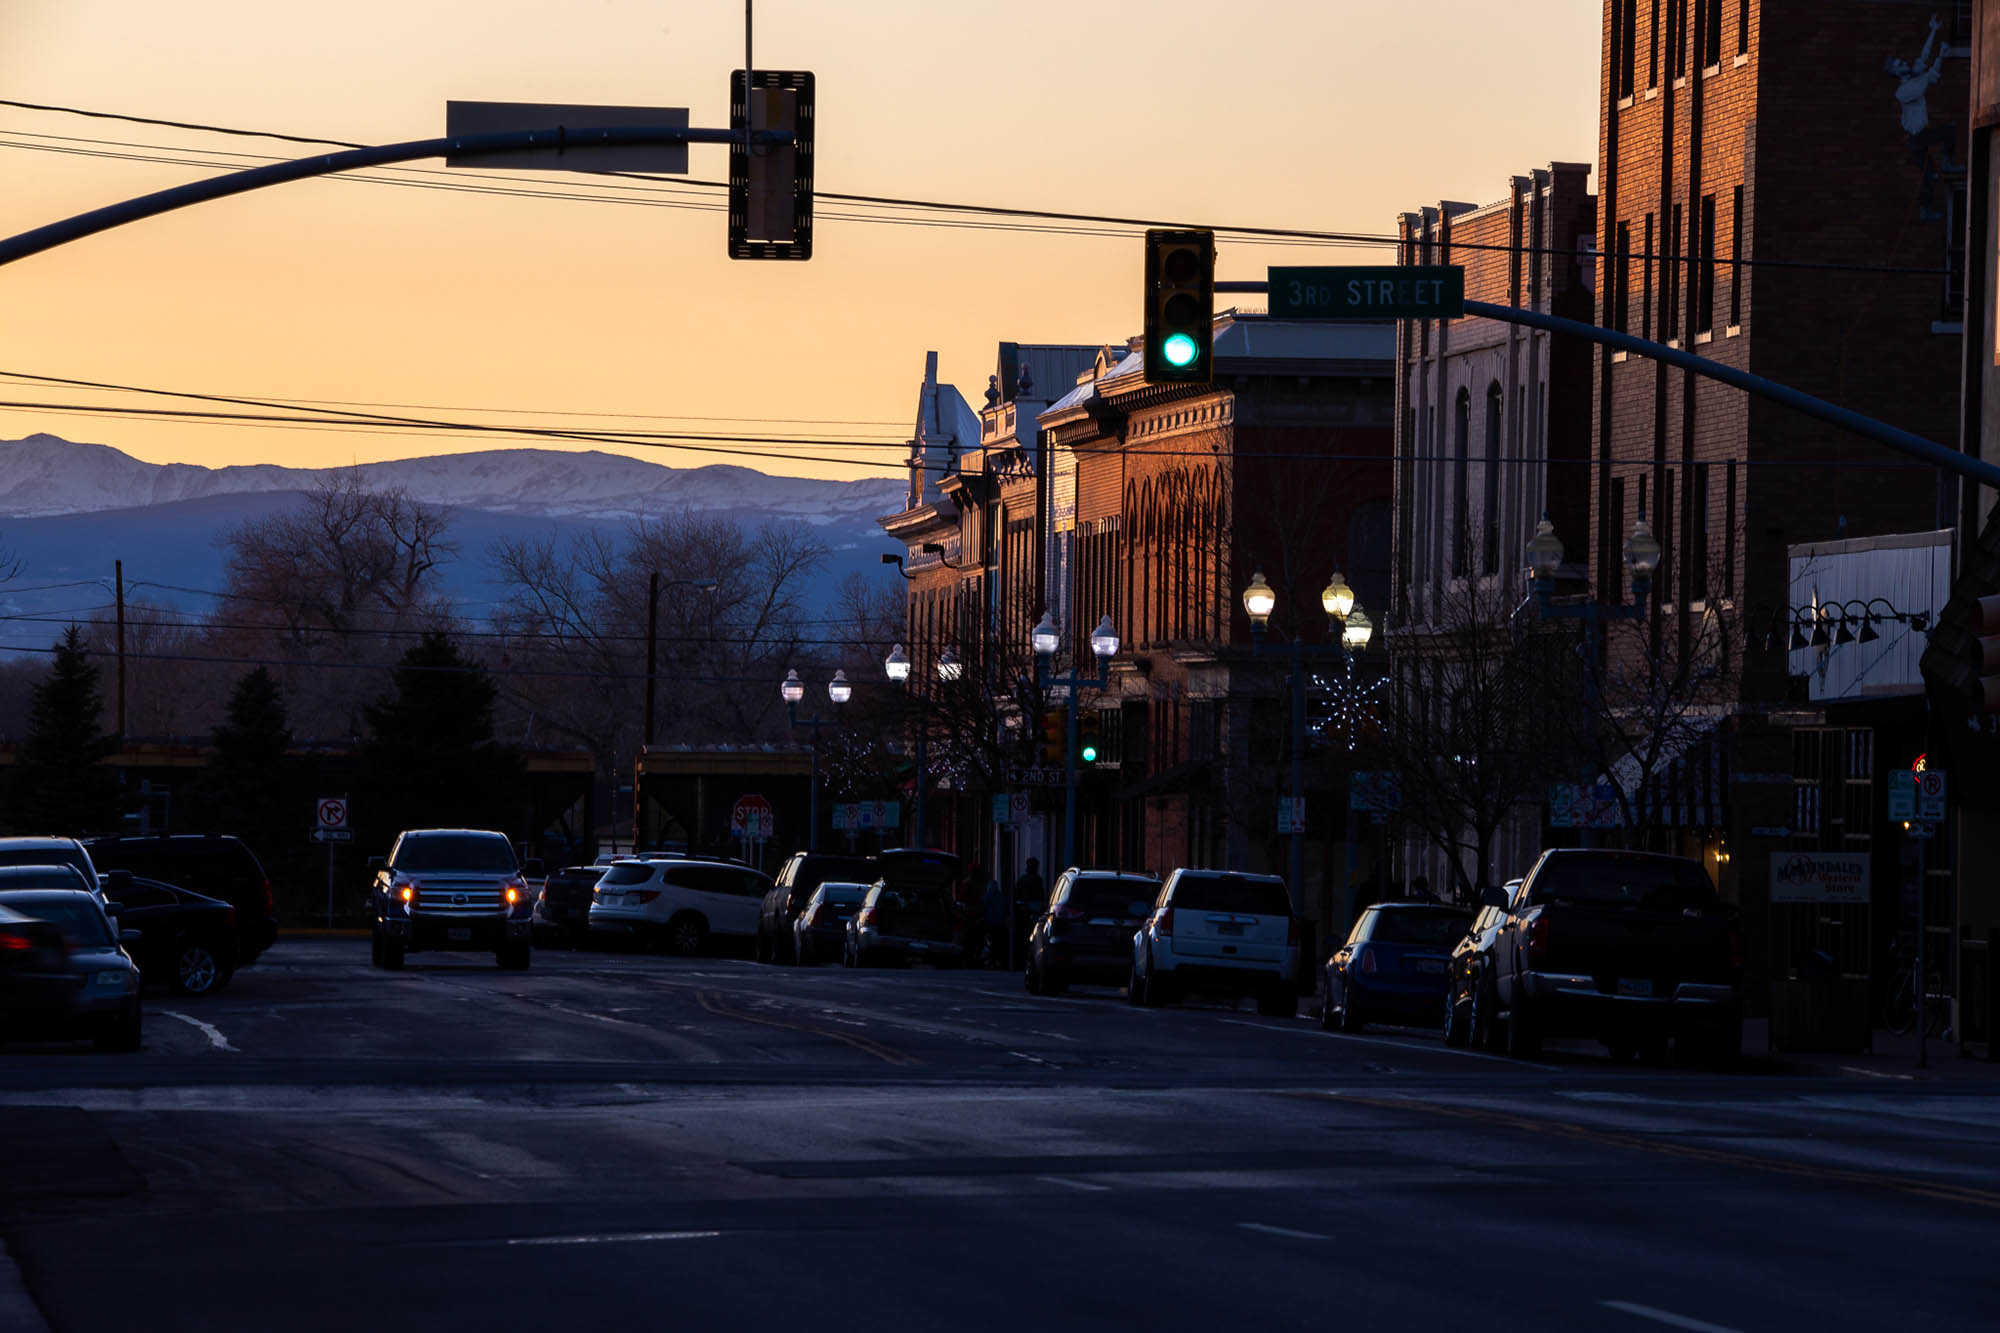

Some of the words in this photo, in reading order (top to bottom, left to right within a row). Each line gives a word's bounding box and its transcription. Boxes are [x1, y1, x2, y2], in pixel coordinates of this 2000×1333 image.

[1288, 280, 1330, 305] 3RD
[1346, 280, 1445, 305] STREET
[736, 806, 769, 821] STOP
